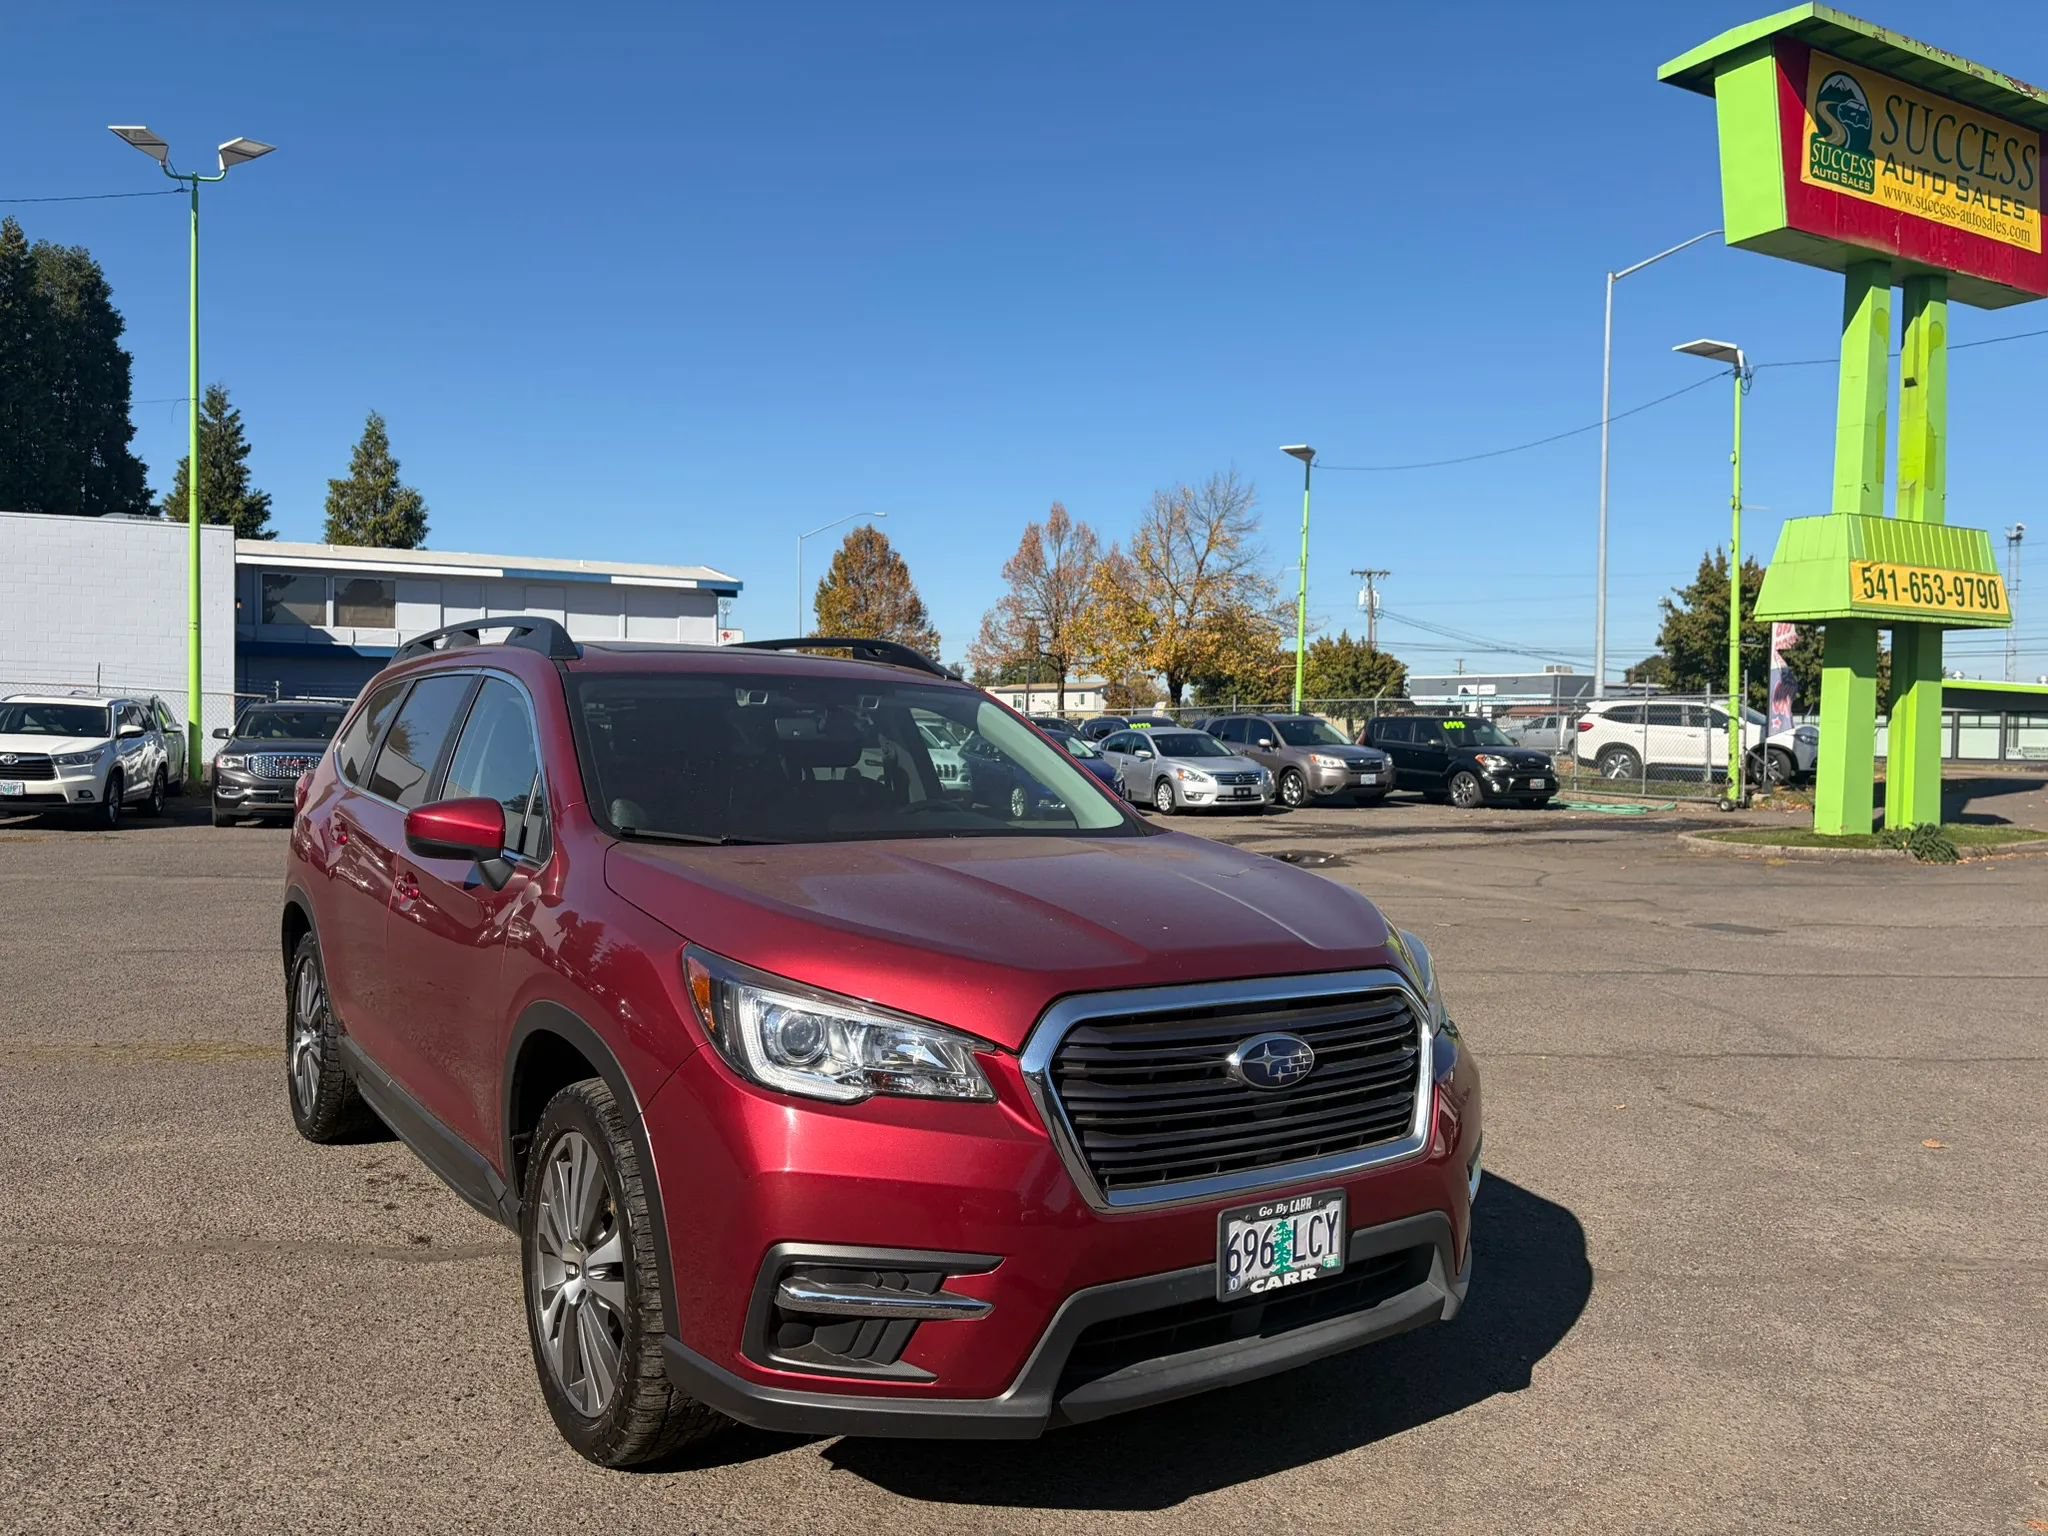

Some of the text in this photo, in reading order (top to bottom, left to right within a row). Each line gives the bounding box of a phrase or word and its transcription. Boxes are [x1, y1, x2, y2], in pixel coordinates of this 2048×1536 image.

[1811, 143, 1874, 179] SUCCESS
[1880, 94, 2036, 192] SUCCESS
[1812, 165, 1871, 191] AUTO SALES
[1882, 152, 1947, 196] AUTO
[1955, 175, 2025, 221] SALES
[1883, 185, 2031, 243] www.success-autosales.com
[1861, 567, 2000, 610] 541-653-9790
[1258, 1196, 1313, 1217] Go By CARR
[1226, 1210, 1339, 1278] 696 LCY
[1249, 1267, 1317, 1294] CARR
